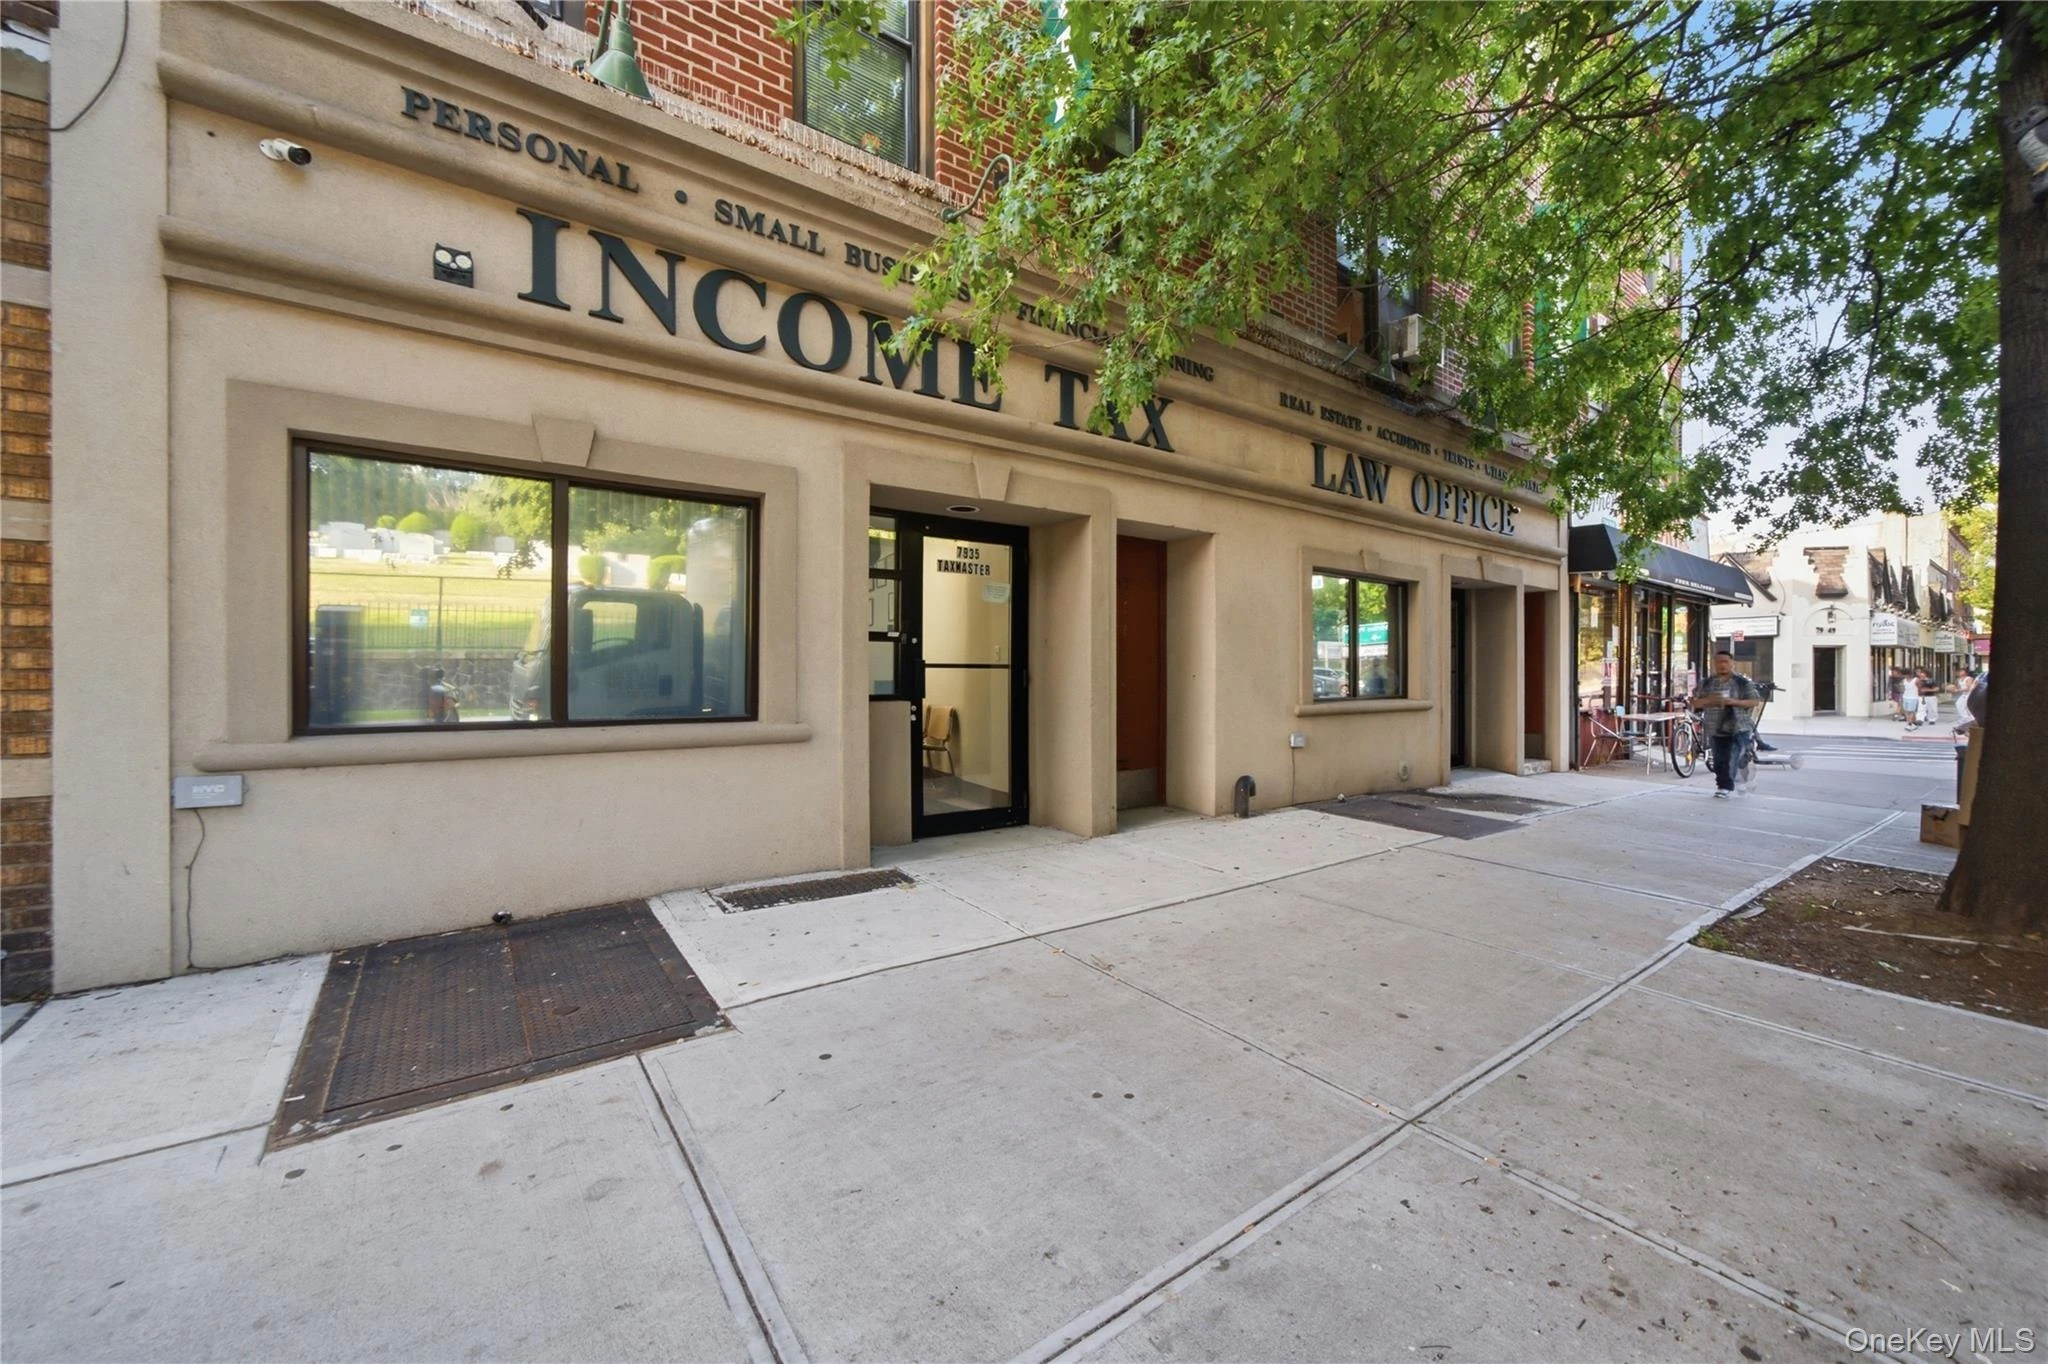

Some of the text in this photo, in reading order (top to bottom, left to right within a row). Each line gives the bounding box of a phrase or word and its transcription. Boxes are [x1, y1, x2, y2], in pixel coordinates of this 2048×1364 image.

[401, 86, 640, 194] PERSONAL
[715, 198, 826, 257] SMALL
[844, 242, 971, 302] BUSIS
[515, 206, 1002, 412] INCOME
[1280, 392, 1314, 416] REAL
[1320, 405, 1362, 432] ESTATE
[1376, 426, 1432, 456] ACCIDENTS
[1310, 442, 1518, 537] LAW OFFICE
[936, 559, 991, 576] TAXMASTER
[956, 546, 981, 560] 7935
